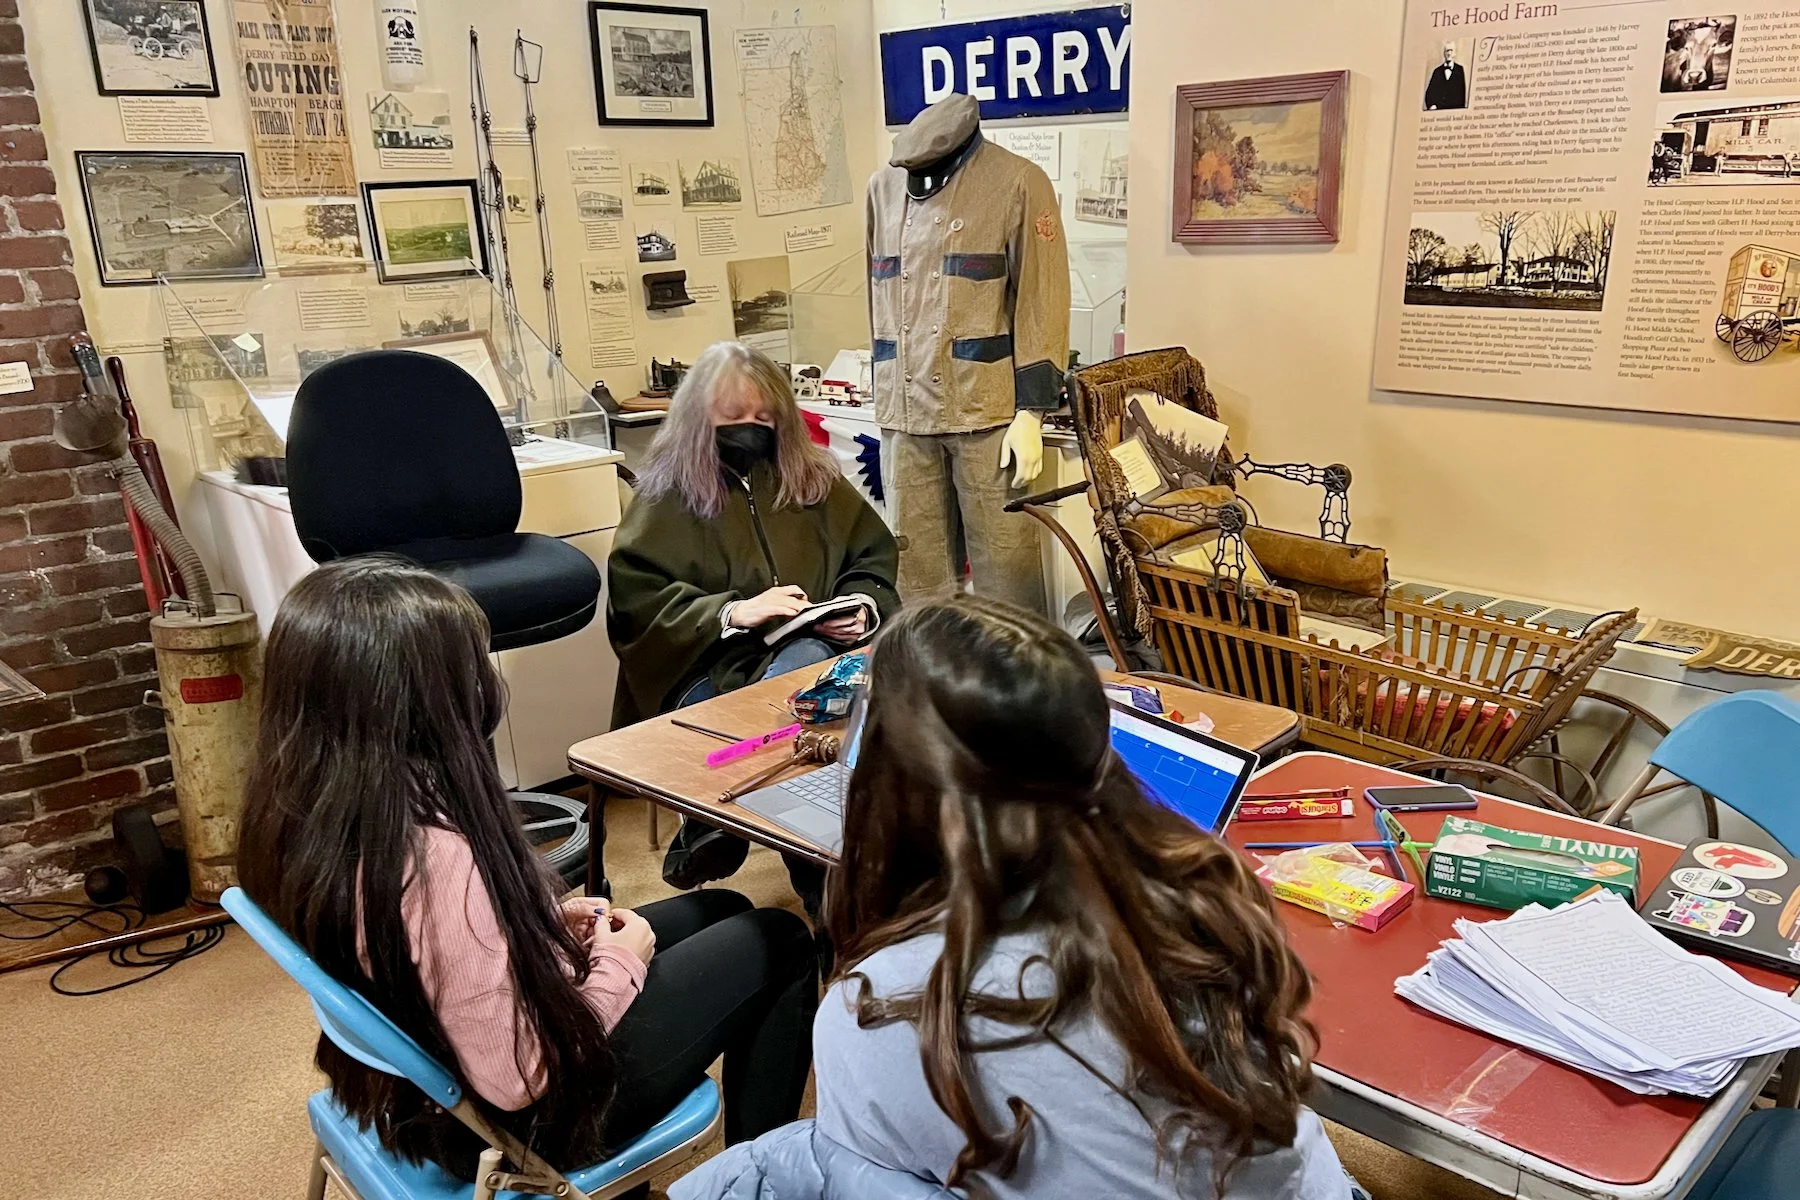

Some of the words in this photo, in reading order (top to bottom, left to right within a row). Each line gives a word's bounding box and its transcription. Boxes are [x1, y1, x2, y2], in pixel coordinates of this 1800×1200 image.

[1431, 11, 1460, 27] The
[1465, 4, 1509, 24] Hood
[1515, 3, 1557, 19] Farm
[238, 22, 259, 39] MAKE
[264, 25, 283, 40] YOUR
[287, 25, 310, 42] PLANS
[315, 27, 332, 43] NOW
[246, 50, 274, 59] DERRY
[281, 51, 306, 61] FIELD
[312, 52, 331, 62] DAY
[922, 24, 1131, 104] DERRY
[246, 62, 339, 95] OUTING
[250, 97, 296, 109] HAMPTON
[309, 99, 342, 110] BEACH
[252, 111, 295, 135] THURSDAY
[306, 112, 326, 136] JULY
[334, 113, 346, 136] 24
[1300, 803, 1337, 814] Starburst
[1556, 836, 1638, 859] VINYL
[1435, 854, 1453, 865] VINYL
[1434, 871, 1455, 882] VINYLE
[1438, 886, 1462, 898] V2122
